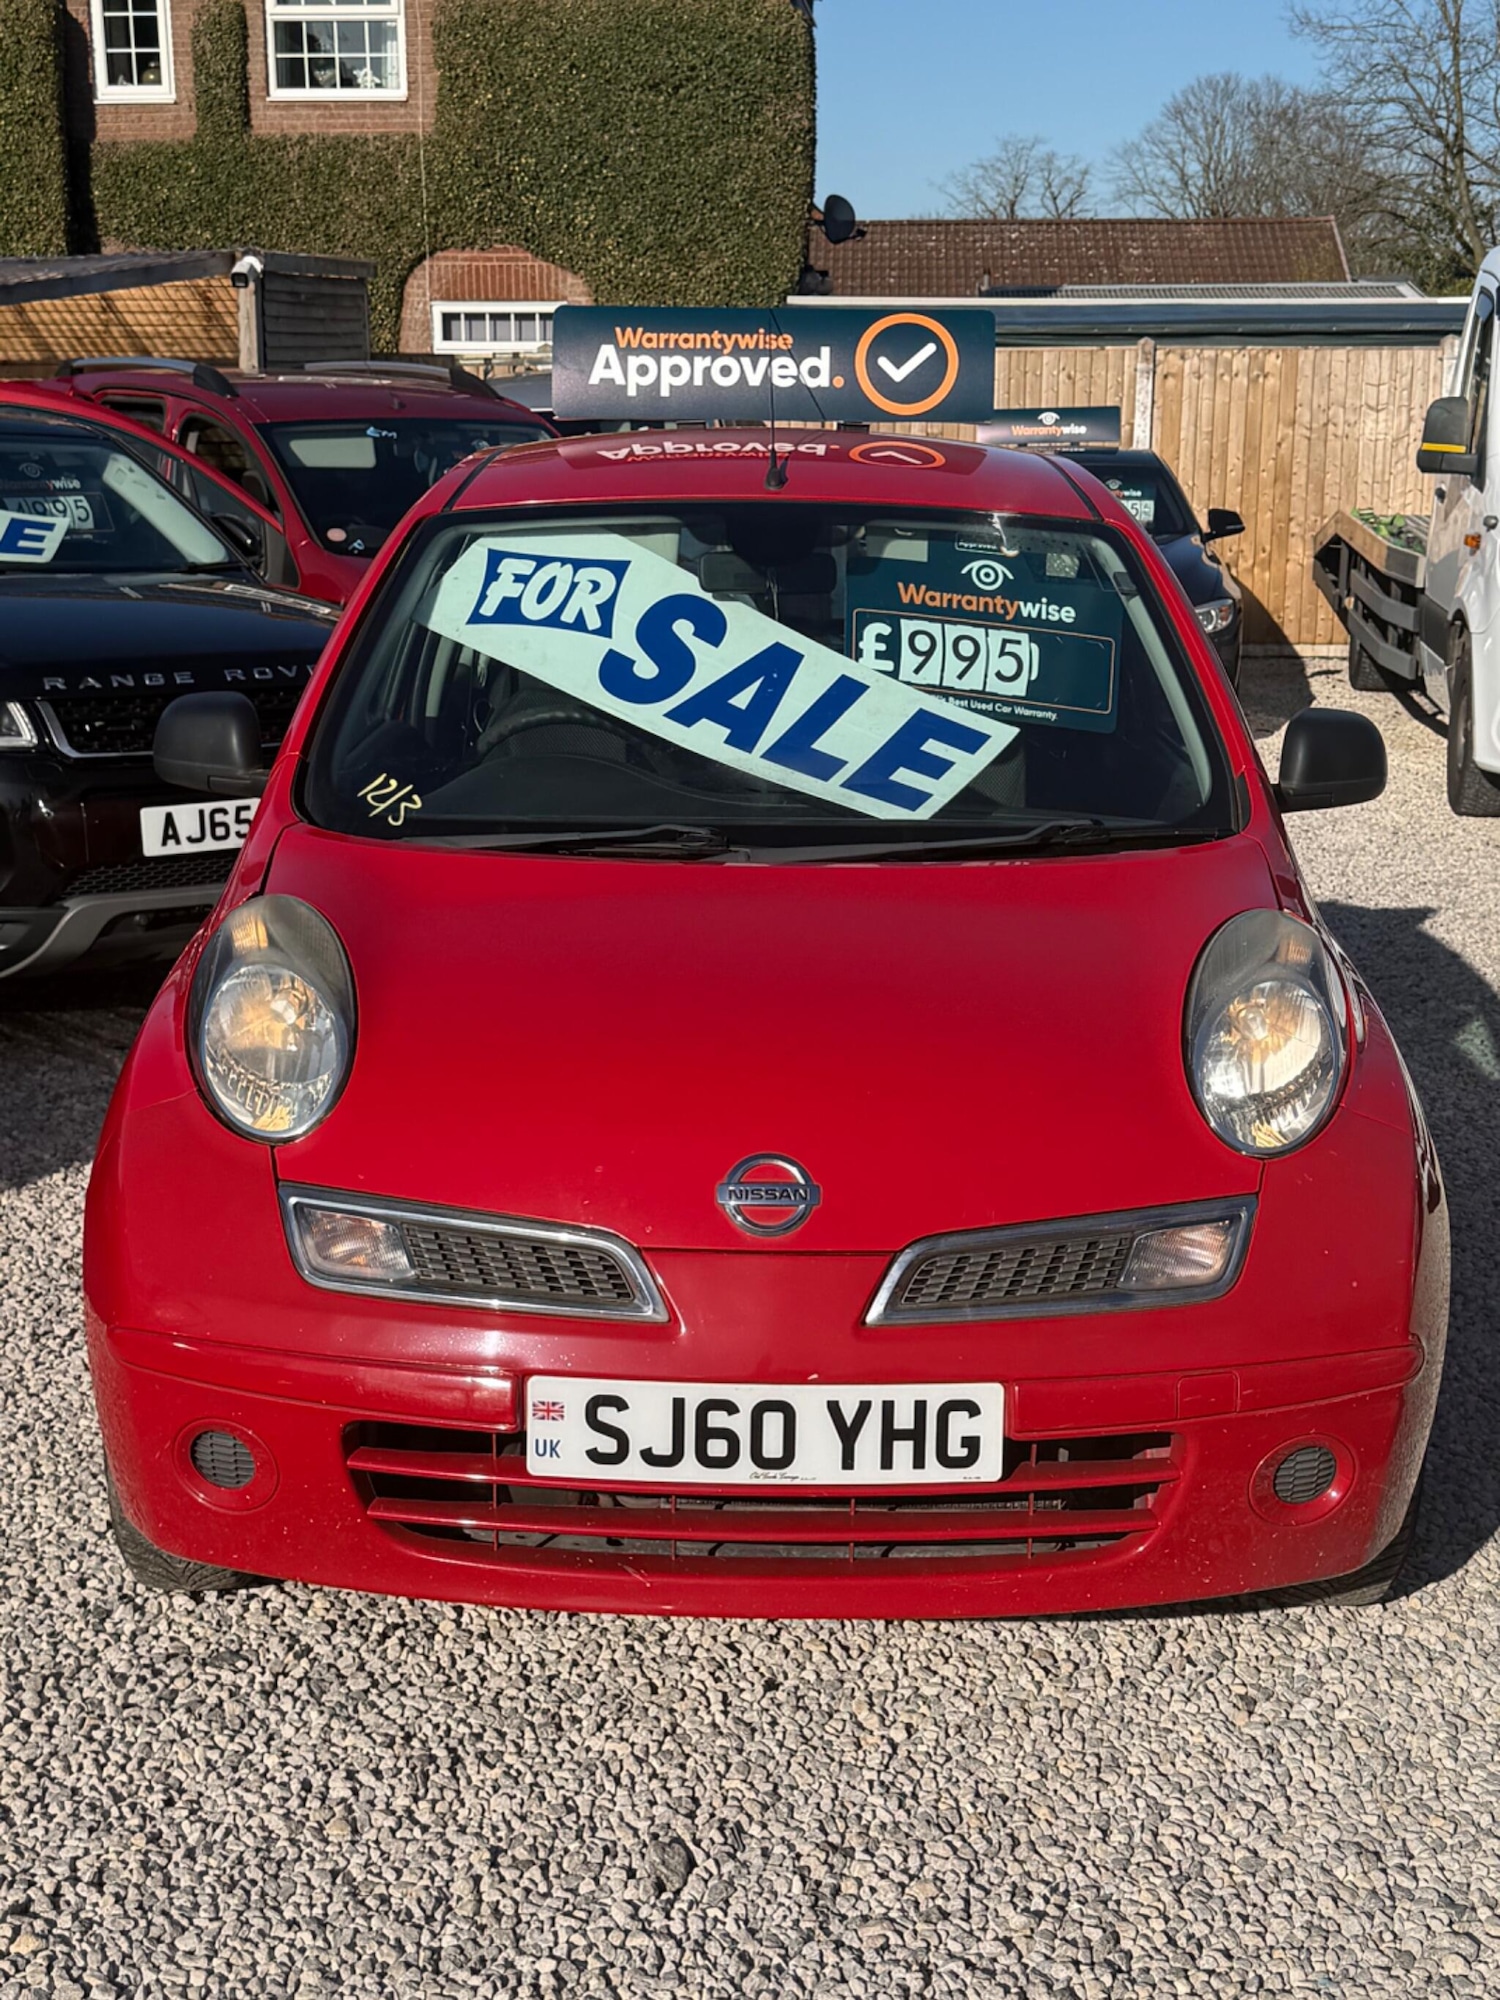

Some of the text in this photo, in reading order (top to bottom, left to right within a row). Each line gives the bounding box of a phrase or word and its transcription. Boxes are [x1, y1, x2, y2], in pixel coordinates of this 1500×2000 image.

[615, 326, 793, 355] Warrantywise
[588, 344, 844, 397] Approved.
[1011, 424, 1087, 437] Warrantywise
[897, 582, 1077, 623] Warrantywise
[43, 664, 314, 690] RANGE ROV
[478, 557, 992, 812] FOR SALE
[970, 699, 993, 712] Used
[994, 702, 1012, 714] Car
[357, 773, 422, 826] 12/3
[161, 805, 252, 847] AJ65
[727, 1186, 811, 1201] NISSAN
[534, 1438, 562, 1459] UK
[584, 1394, 982, 1471] SJ60 YHG
